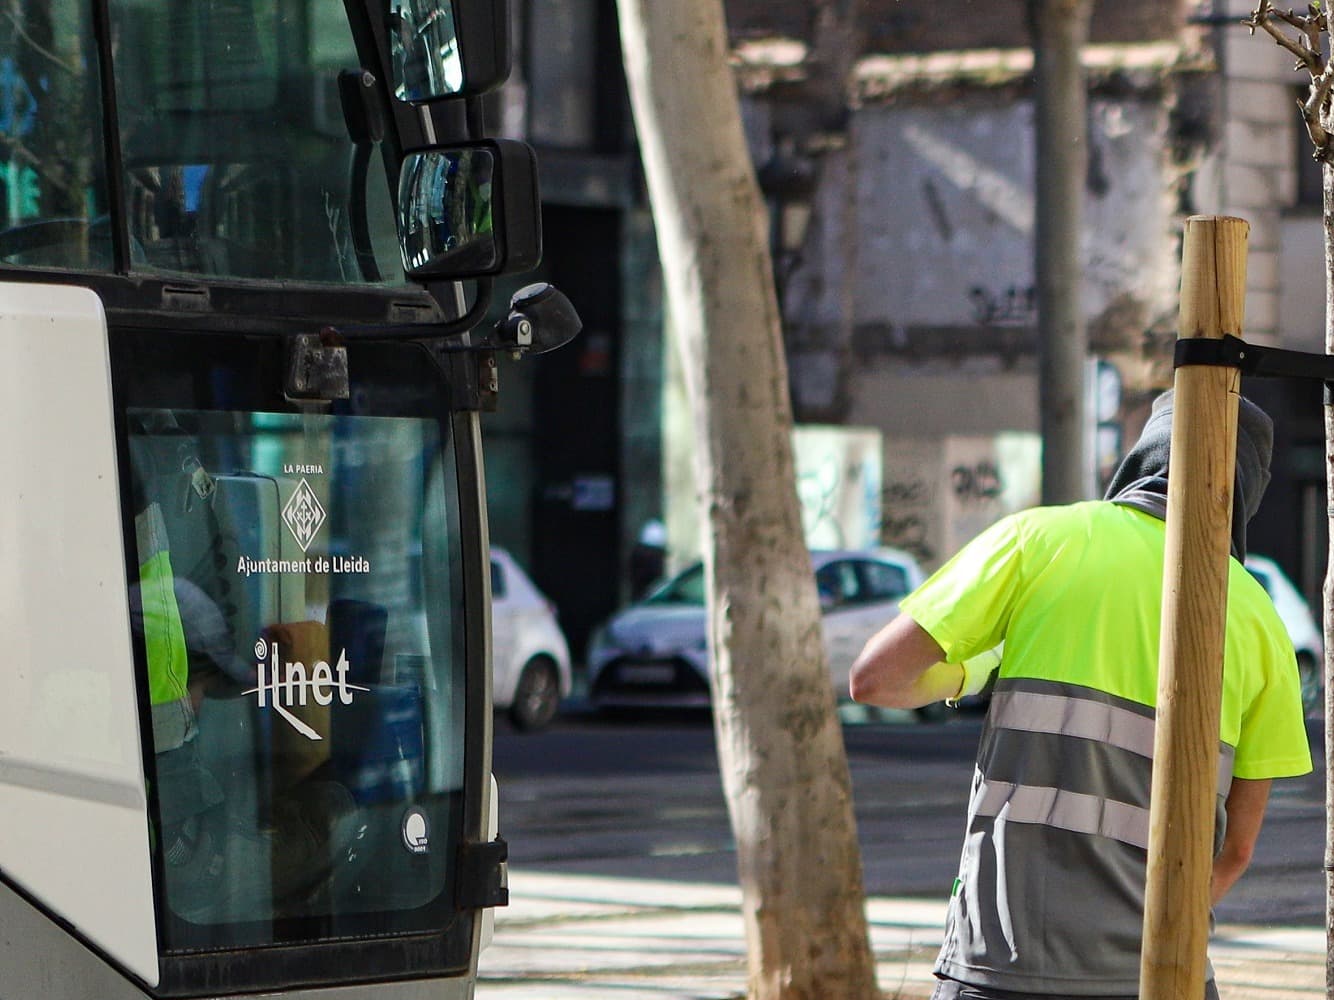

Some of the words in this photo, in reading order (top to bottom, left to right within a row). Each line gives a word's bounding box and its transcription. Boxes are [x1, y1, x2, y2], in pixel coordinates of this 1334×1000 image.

[284, 464, 294, 474] LA
[295, 464, 323, 474] PAERIA
[237, 556, 312, 577] Ajuntament
[315, 556, 329, 573] de
[332, 556, 370, 573] Lleida
